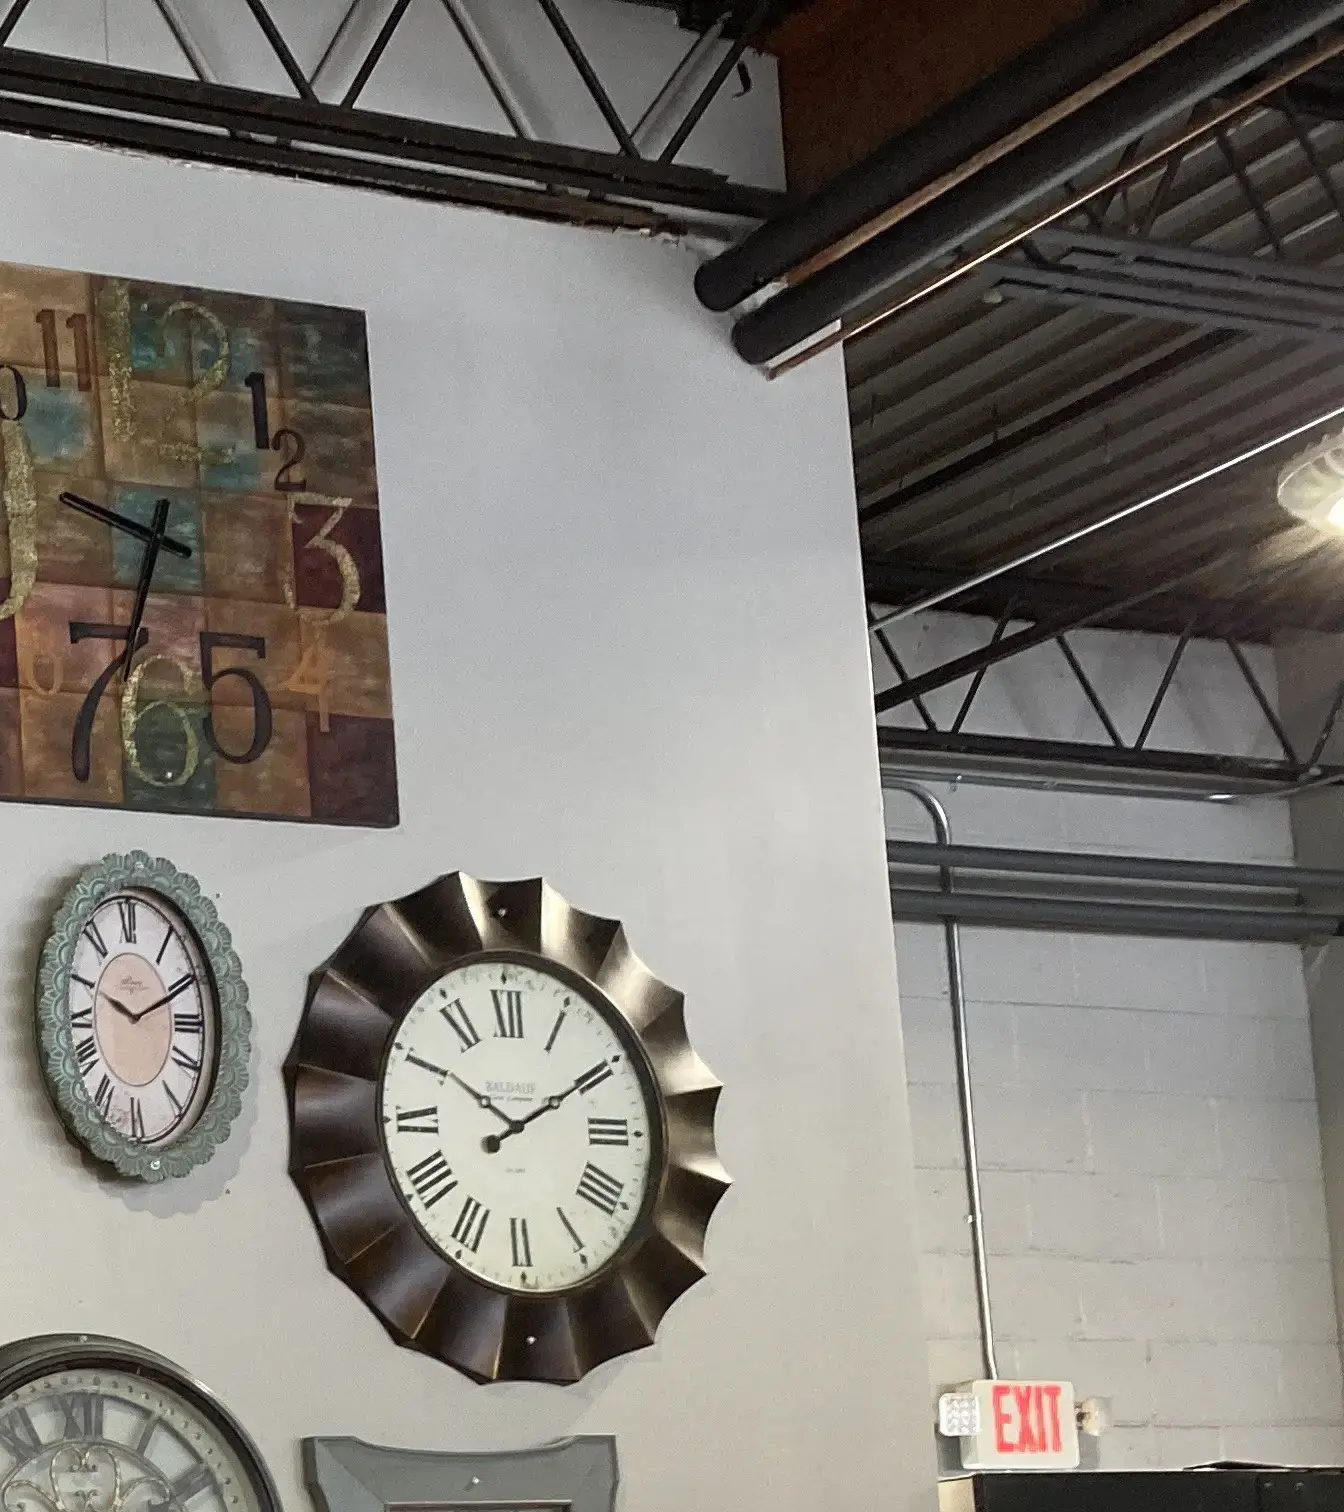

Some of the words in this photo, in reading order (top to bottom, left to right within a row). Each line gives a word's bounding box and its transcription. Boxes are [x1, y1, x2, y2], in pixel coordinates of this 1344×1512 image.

[35, 308, 92, 392] 11
[244, 372, 269, 450] 1
[271, 429, 307, 492] 2
[284, 491, 362, 627] 3
[69, 621, 149, 783] 7
[121, 654, 199, 787] 6
[199, 631, 273, 764] 5
[174, 1013, 200, 1033] III
[490, 989, 524, 1039] XII
[544, 1009, 567, 1052] I
[587, 1117, 629, 1146] III
[575, 1161, 625, 1216] IIII
[992, 1385, 1062, 1454] EXIT
